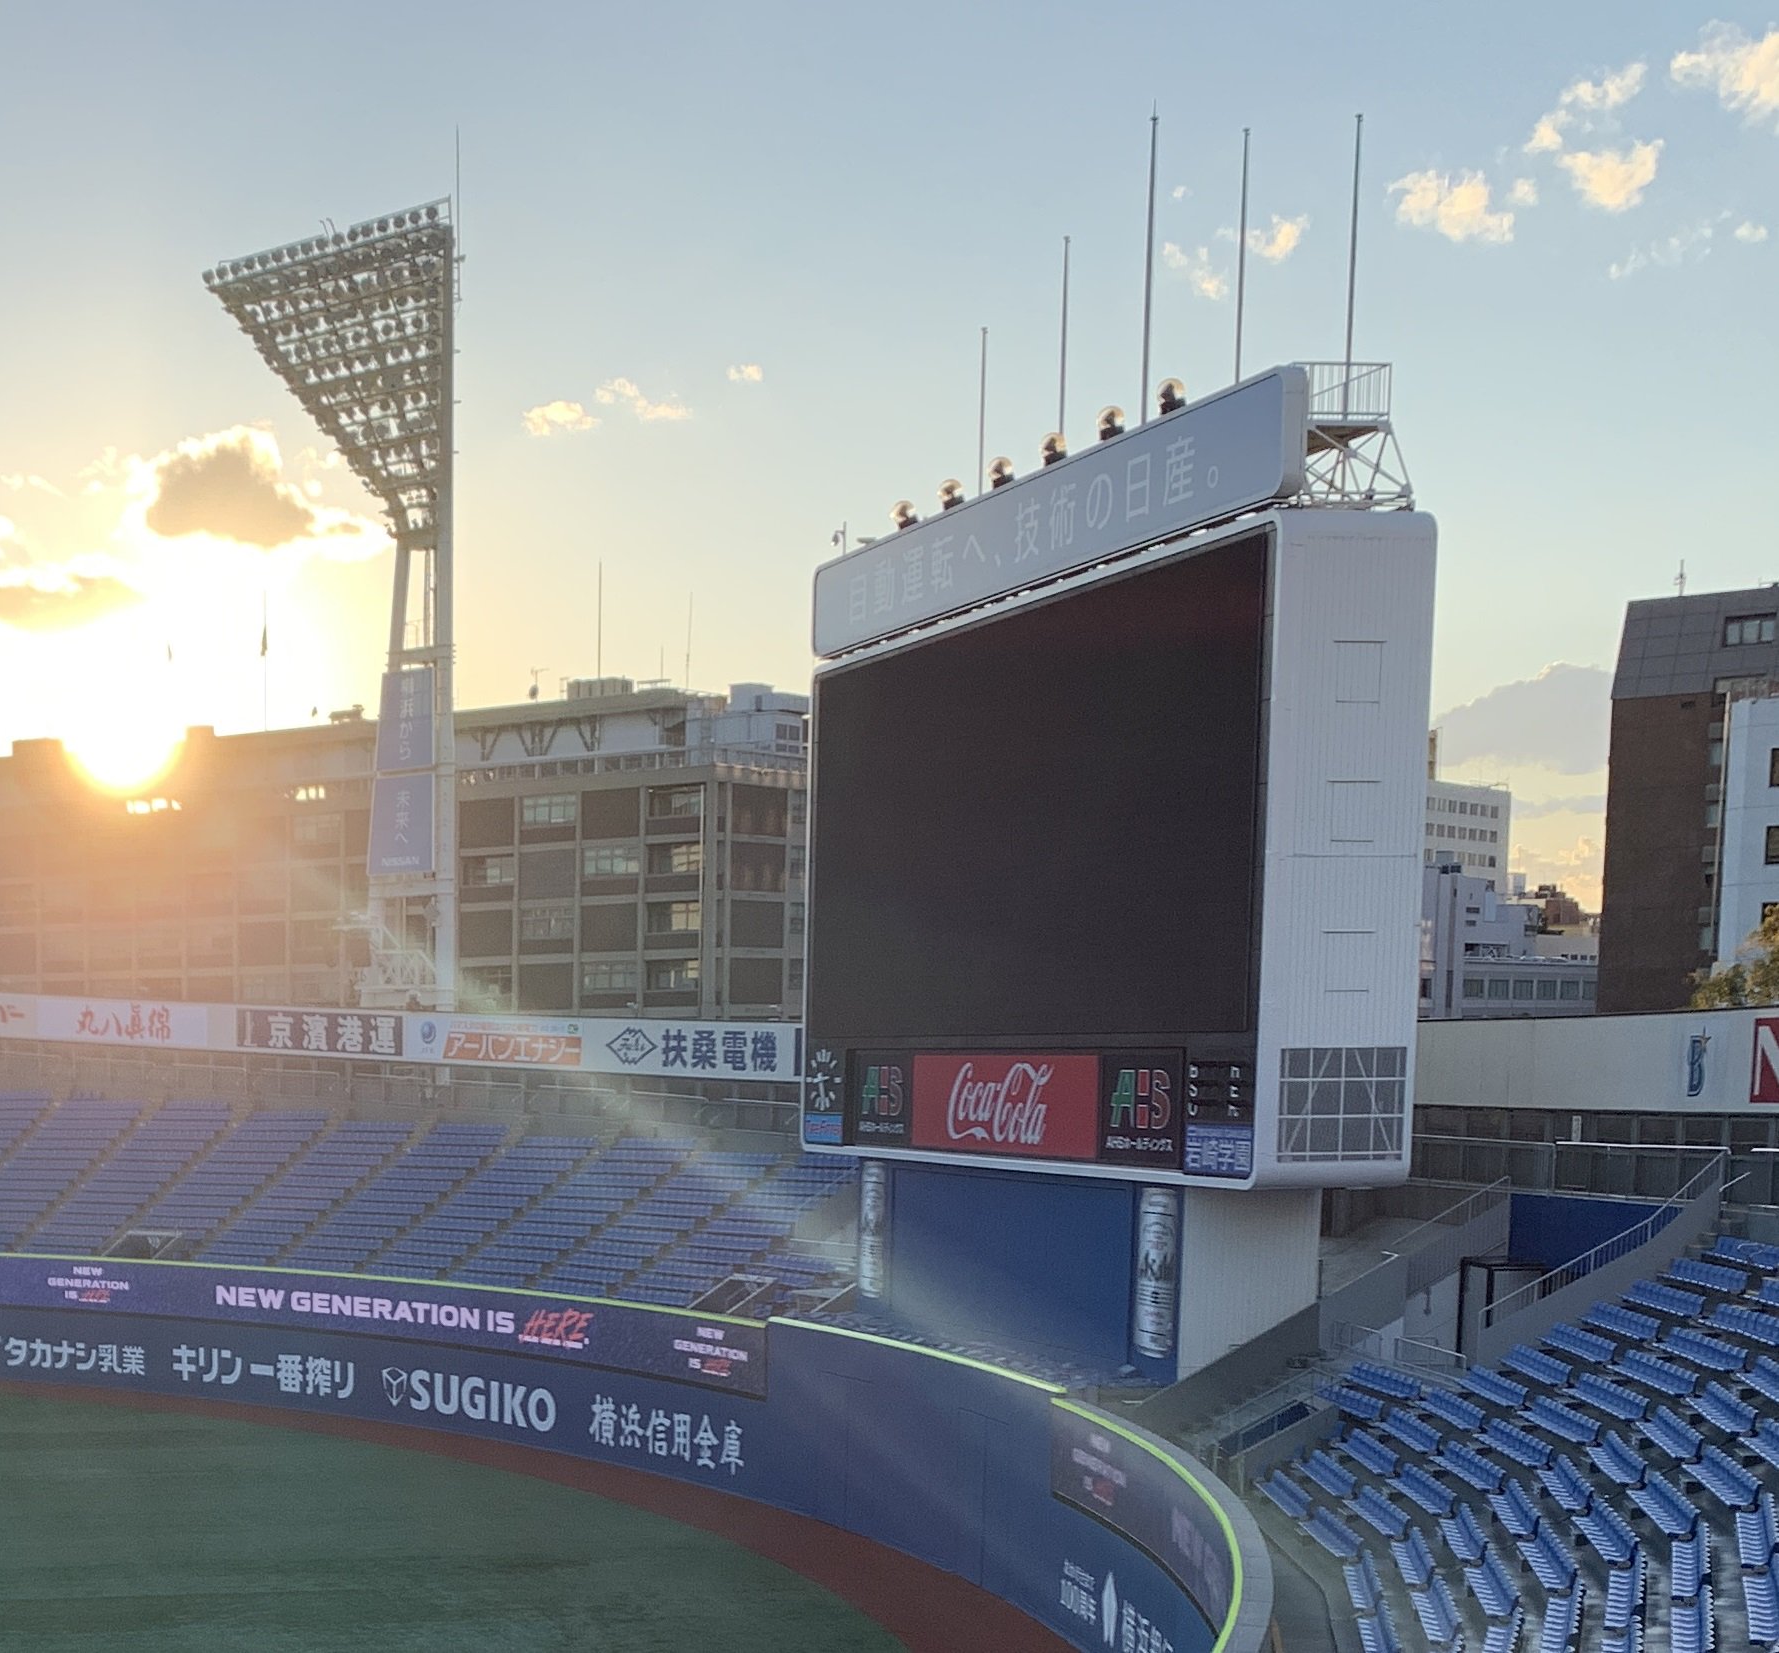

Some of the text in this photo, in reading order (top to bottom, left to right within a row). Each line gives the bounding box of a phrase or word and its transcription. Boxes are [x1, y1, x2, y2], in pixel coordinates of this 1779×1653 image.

[394, 790, 412, 844] 未来へ
[380, 855, 421, 867] NISSAN
[448, 1033, 580, 1063] アーバンエナジー
[661, 1028, 779, 1073] 扶桑電機
[1185, 1137, 1251, 1171] 岩崎学園
[47, 1277, 130, 1291] GENERATION
[72, 1265, 103, 1277] NEW
[64, 1290, 78, 1299] IS
[215, 1285, 285, 1311] NEW
[290, 1292, 480, 1331] GENERATION
[487, 1310, 515, 1335] IS
[696, 1326, 725, 1340] NEW
[4, 1336, 146, 1376] タカナシ乳業
[673, 1339, 749, 1362] GENERATION
[688, 1357, 702, 1369] IS
[410, 1369, 557, 1433] SUGIKO
[589, 1394, 745, 1476] 横浜信用金庫
